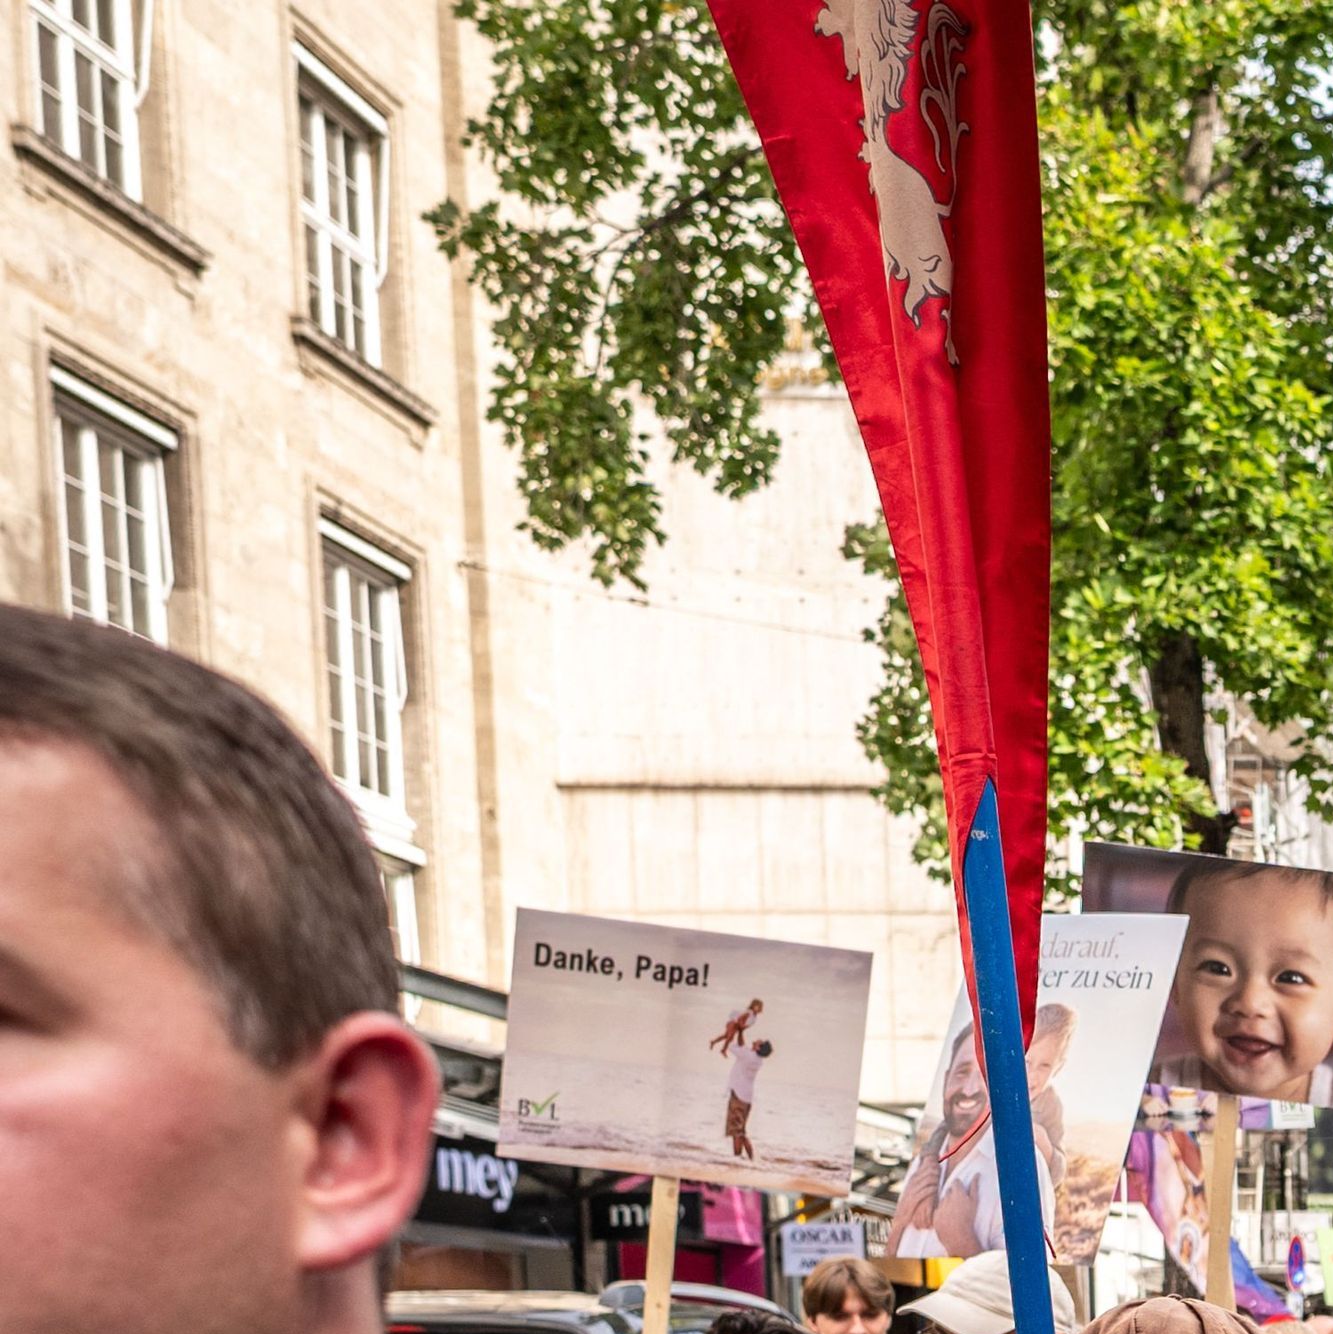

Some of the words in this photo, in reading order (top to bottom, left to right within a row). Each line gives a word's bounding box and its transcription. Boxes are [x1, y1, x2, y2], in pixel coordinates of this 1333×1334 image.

[534, 942, 624, 982] Danke,
[635, 955, 710, 989] Papa!
[1071, 971, 1099, 988] zu
[1103, 965, 1154, 989] sein
[436, 1146, 519, 1213] mey
[790, 1227, 854, 1244] OSCAR
